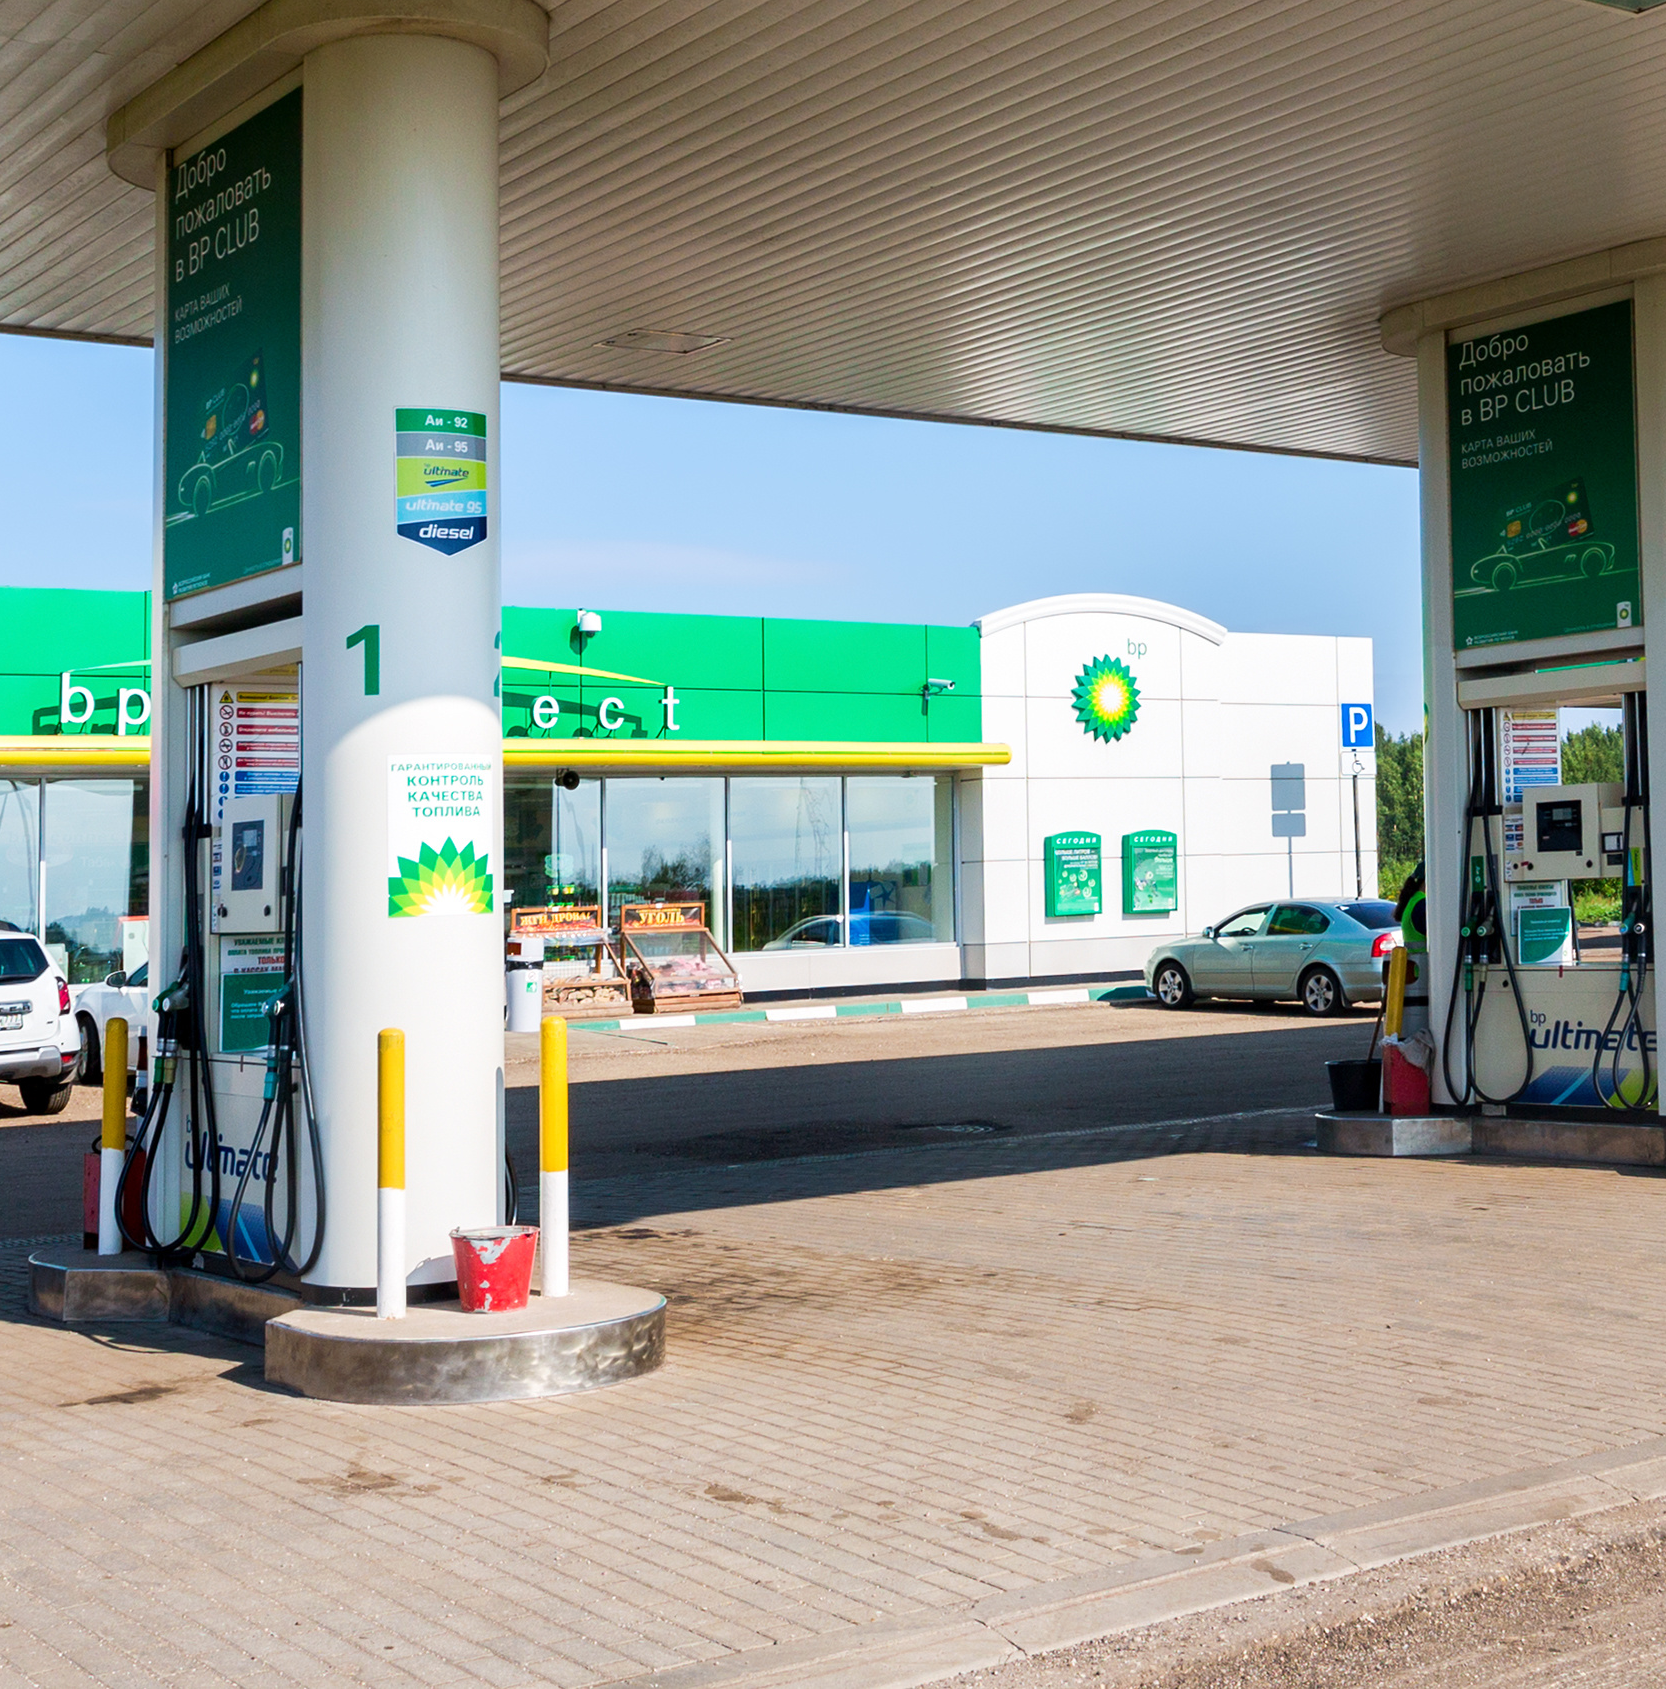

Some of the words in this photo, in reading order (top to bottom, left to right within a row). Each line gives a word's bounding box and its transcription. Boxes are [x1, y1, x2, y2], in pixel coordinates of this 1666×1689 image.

[175, 148, 227, 204] Добро
[176, 166, 271, 240] пожаловать
[175, 259, 185, 282] в
[189, 235, 210, 275] BP
[215, 208, 260, 259] CLUB
[175, 298, 198, 322] КАРТА
[200, 283, 230, 309] ВАШИХ
[175, 295, 242, 344] ВОЗМОЖНОСТЕЙ
[1459, 334, 1528, 370] Добро
[1461, 351, 1590, 396] пожаловать
[1461, 409, 1473, 425] в
[1480, 394, 1508, 421] BP
[1515, 379, 1575, 412] CLUB
[425, 415, 443, 426] Аи
[454, 417, 468, 428] 92
[425, 439, 443, 451] Аи
[454, 441, 468, 453] 95
[1461, 438, 1493, 454] КАРТА
[1496, 429, 1536, 447] ВАШИХ
[1461, 438, 1553, 469] ВОЗМОЖНОСТЕЙ
[423, 466, 469, 478] ultimate
[405, 498, 464, 512] ultimate
[466, 501, 482, 514] 95
[419, 524, 474, 540] diesel
[345, 625, 380, 695] 1
[1127, 638, 1148, 659] bp
[60, 672, 152, 736] bp
[1348, 706, 1368, 744] P
[407, 775, 484, 787] КОНТРОЛЬ
[407, 790, 484, 802] КАЧЕСТВА
[412, 806, 481, 818] ТОПЛИВА
[1056, 836, 1097, 845] СЕГОДНЯ
[1134, 835, 1173, 843] СЕГОДНЯ
[639, 911, 685, 924] УГОЛЬ
[1530, 1010, 1547, 1027] bp
[1530, 1020, 1657, 1051] ultimate
